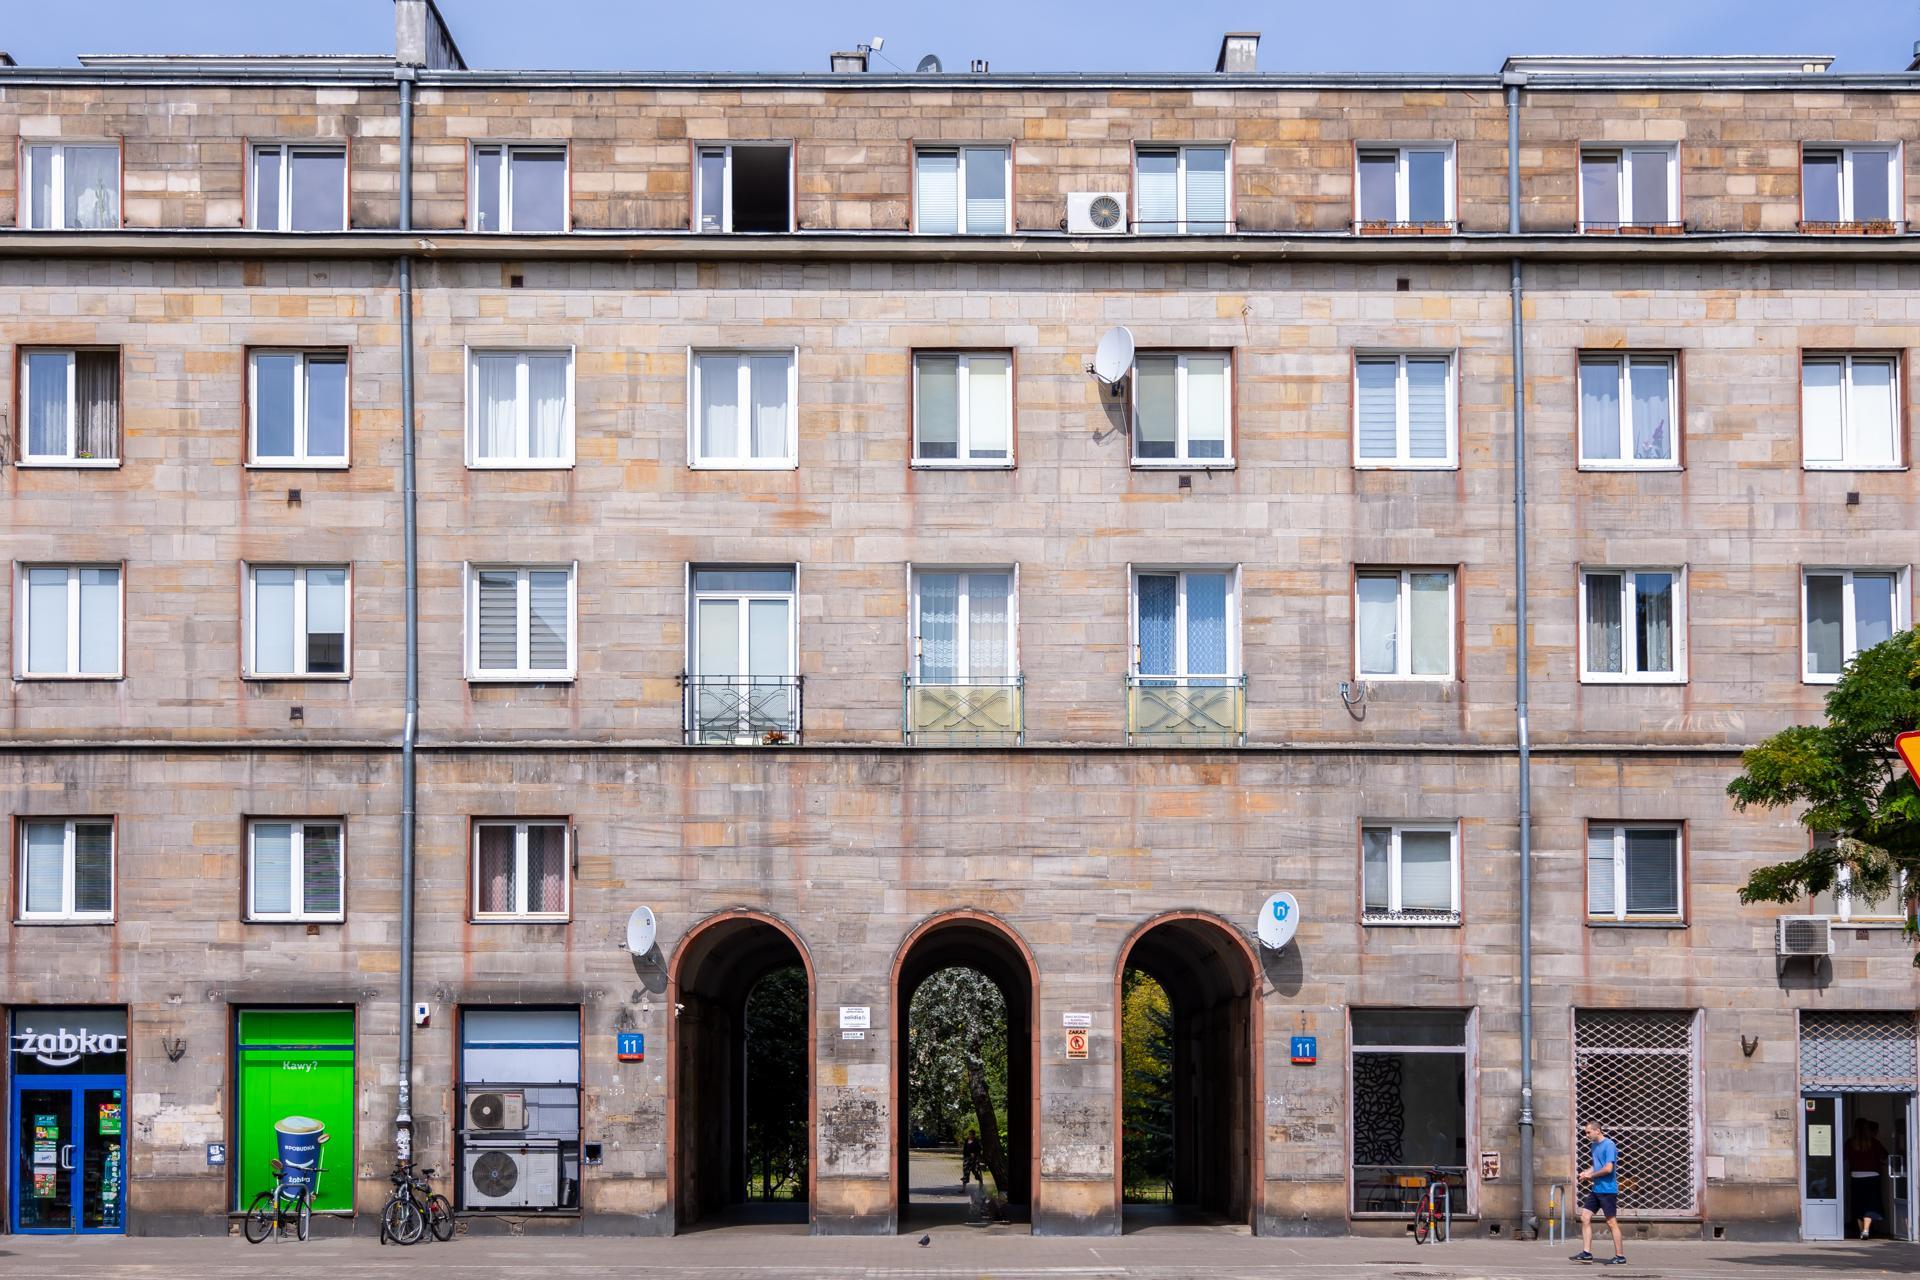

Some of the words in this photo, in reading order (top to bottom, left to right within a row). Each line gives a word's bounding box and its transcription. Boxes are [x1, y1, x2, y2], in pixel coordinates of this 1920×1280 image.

[20, 1027, 117, 1053] żabka
[623, 1039, 637, 1053] 11
[1296, 1043, 1310, 1056] 11
[282, 1060, 318, 1072] Kawy?
